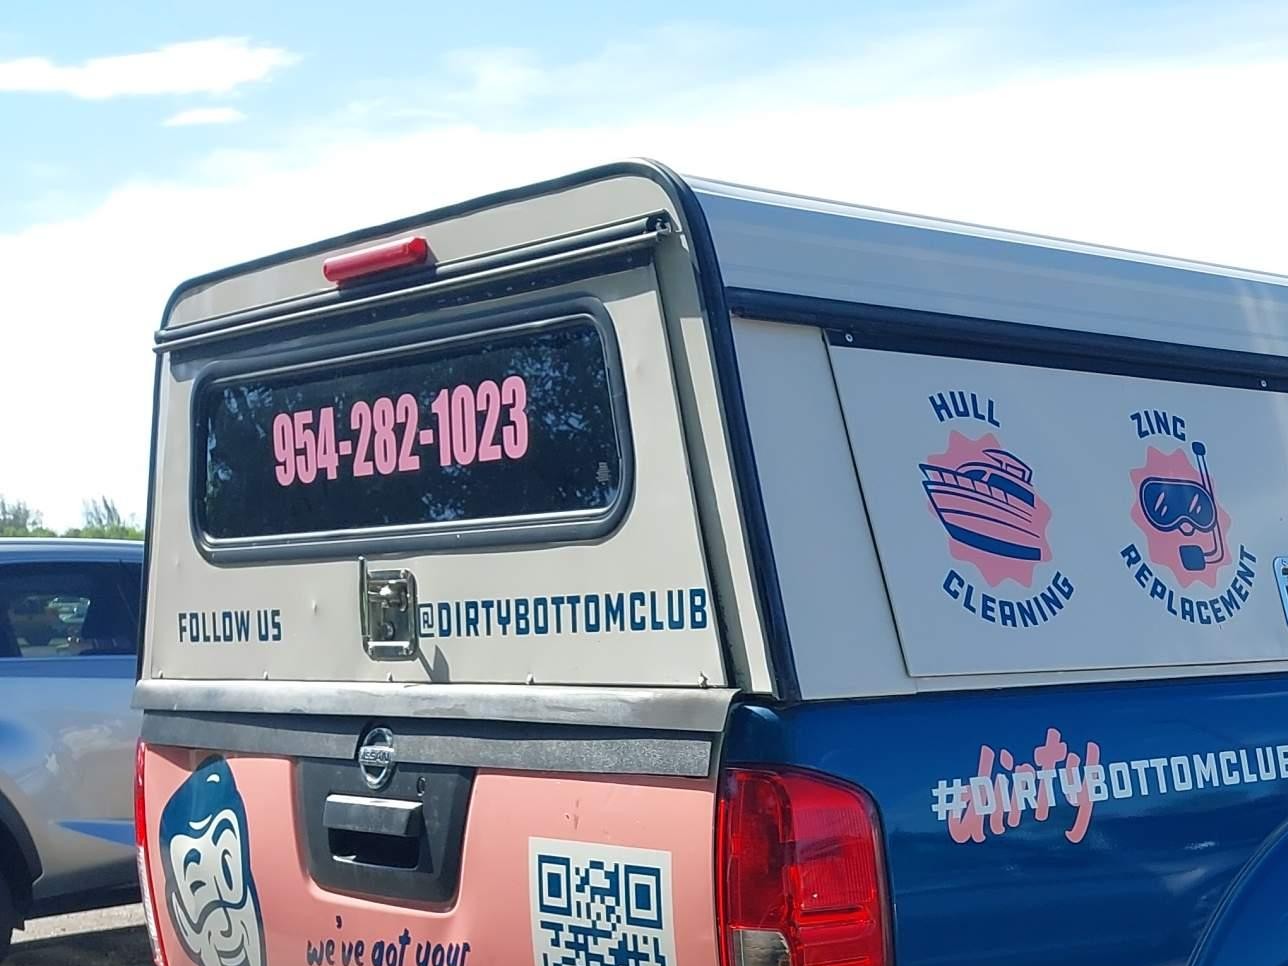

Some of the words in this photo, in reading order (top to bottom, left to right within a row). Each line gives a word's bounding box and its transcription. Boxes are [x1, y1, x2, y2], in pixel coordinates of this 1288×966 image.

[273, 375, 529, 487] 954-282-1023
[928, 390, 1001, 428] HULL
[1130, 409, 1187, 441] ZINC
[942, 568, 1075, 629] CLEANING
[1119, 543, 1258, 626] REPLACEMENT
[177, 609, 251, 644] FOLLOW
[256, 609, 283, 642] US
[417, 587, 708, 638] @DIRTYBOTTOMCLUB
